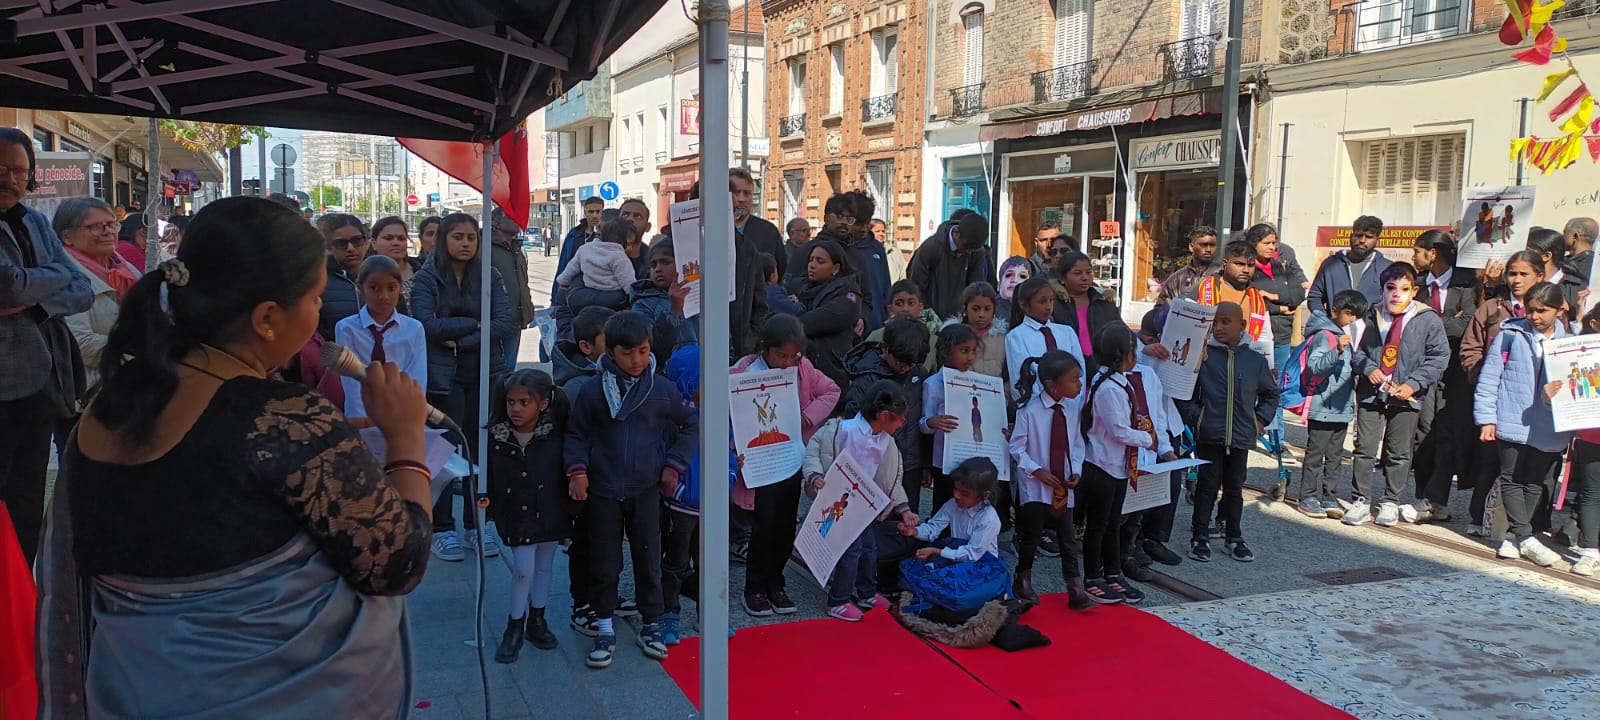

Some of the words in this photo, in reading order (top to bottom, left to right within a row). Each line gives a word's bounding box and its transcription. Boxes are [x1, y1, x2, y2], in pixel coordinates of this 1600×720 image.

[1036, 118, 1068, 134] CONFORT
[1077, 108, 1132, 128] CHAUSSURES
[1137, 142, 1174, 168] Confort
[1175, 138, 1221, 162] CHAUSSUR
